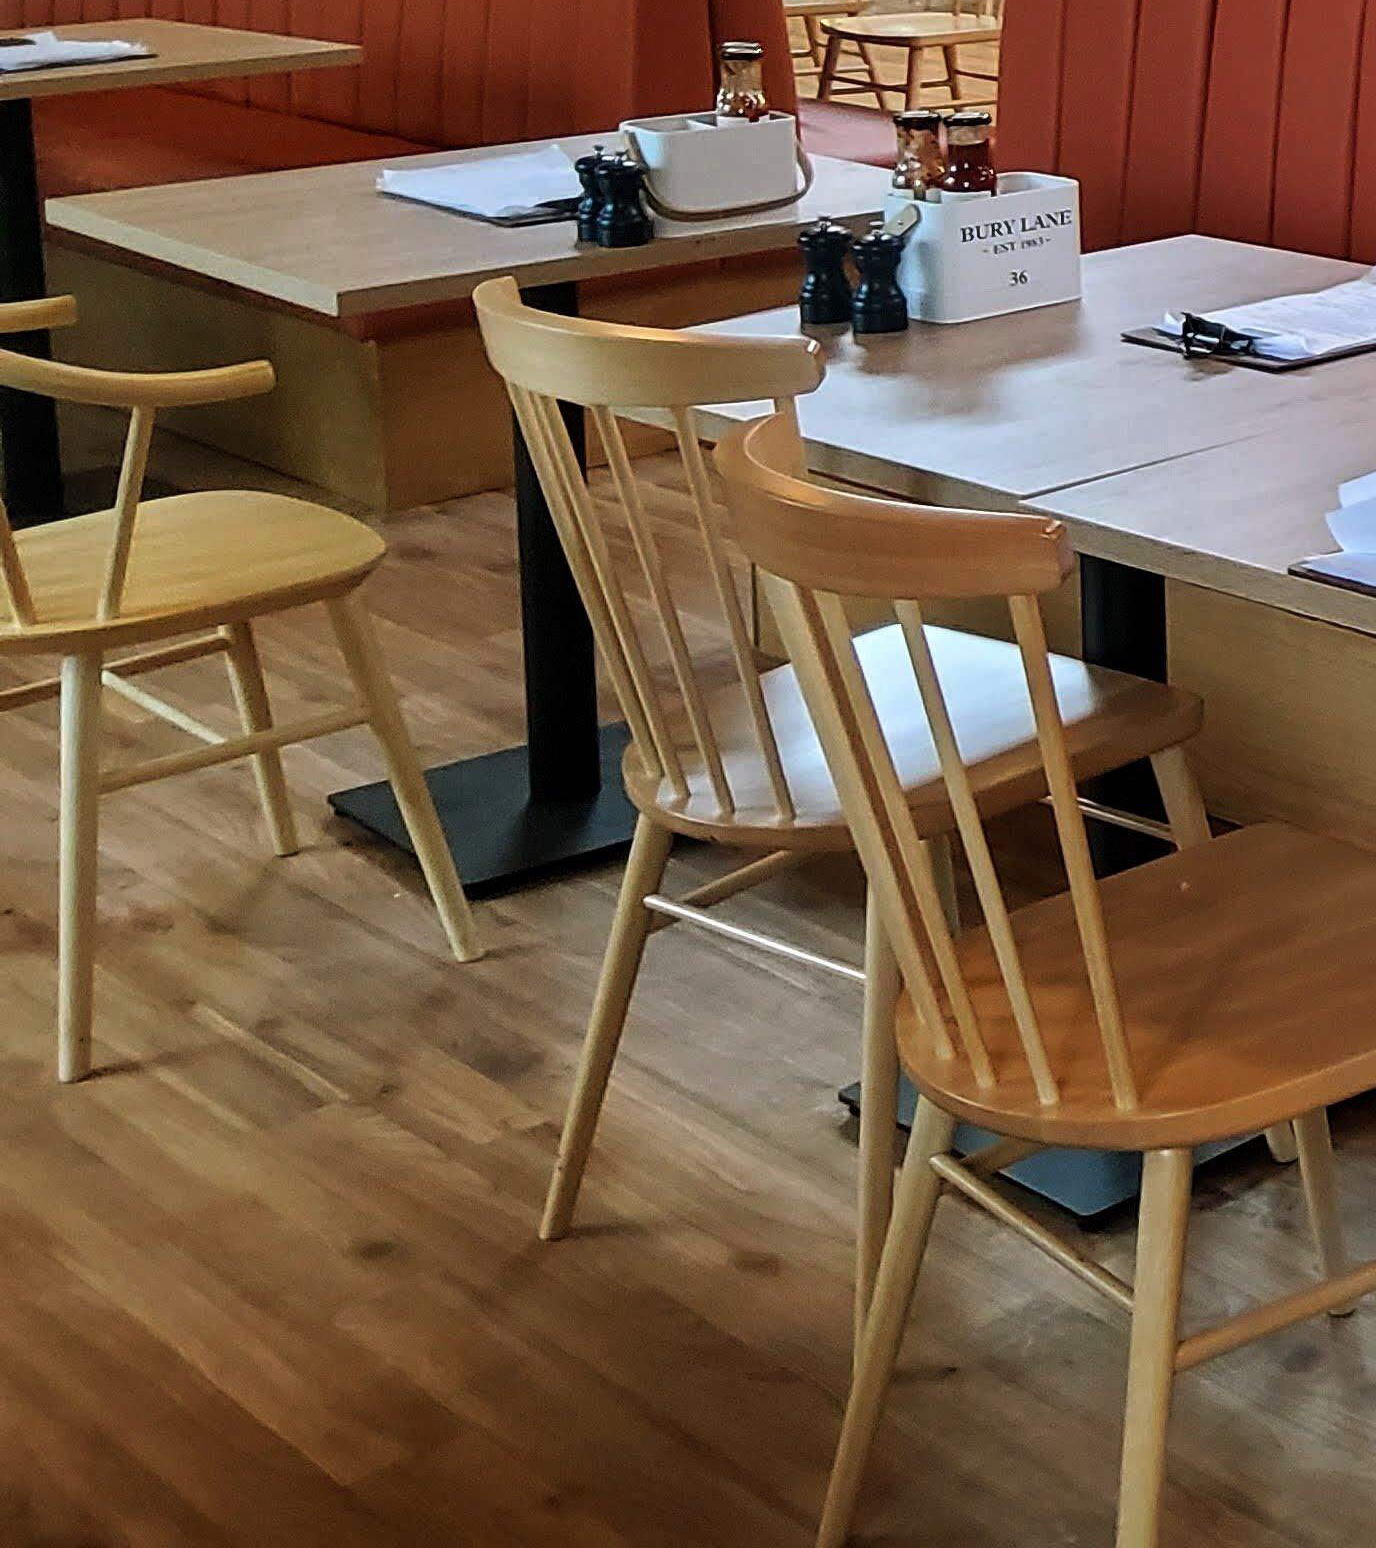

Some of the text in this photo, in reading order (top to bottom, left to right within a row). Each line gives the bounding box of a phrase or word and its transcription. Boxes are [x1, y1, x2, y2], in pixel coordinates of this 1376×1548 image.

[961, 209, 1072, 243] BURY LANE
[993, 241, 1016, 254] EST
[1009, 270, 1028, 287] 36
